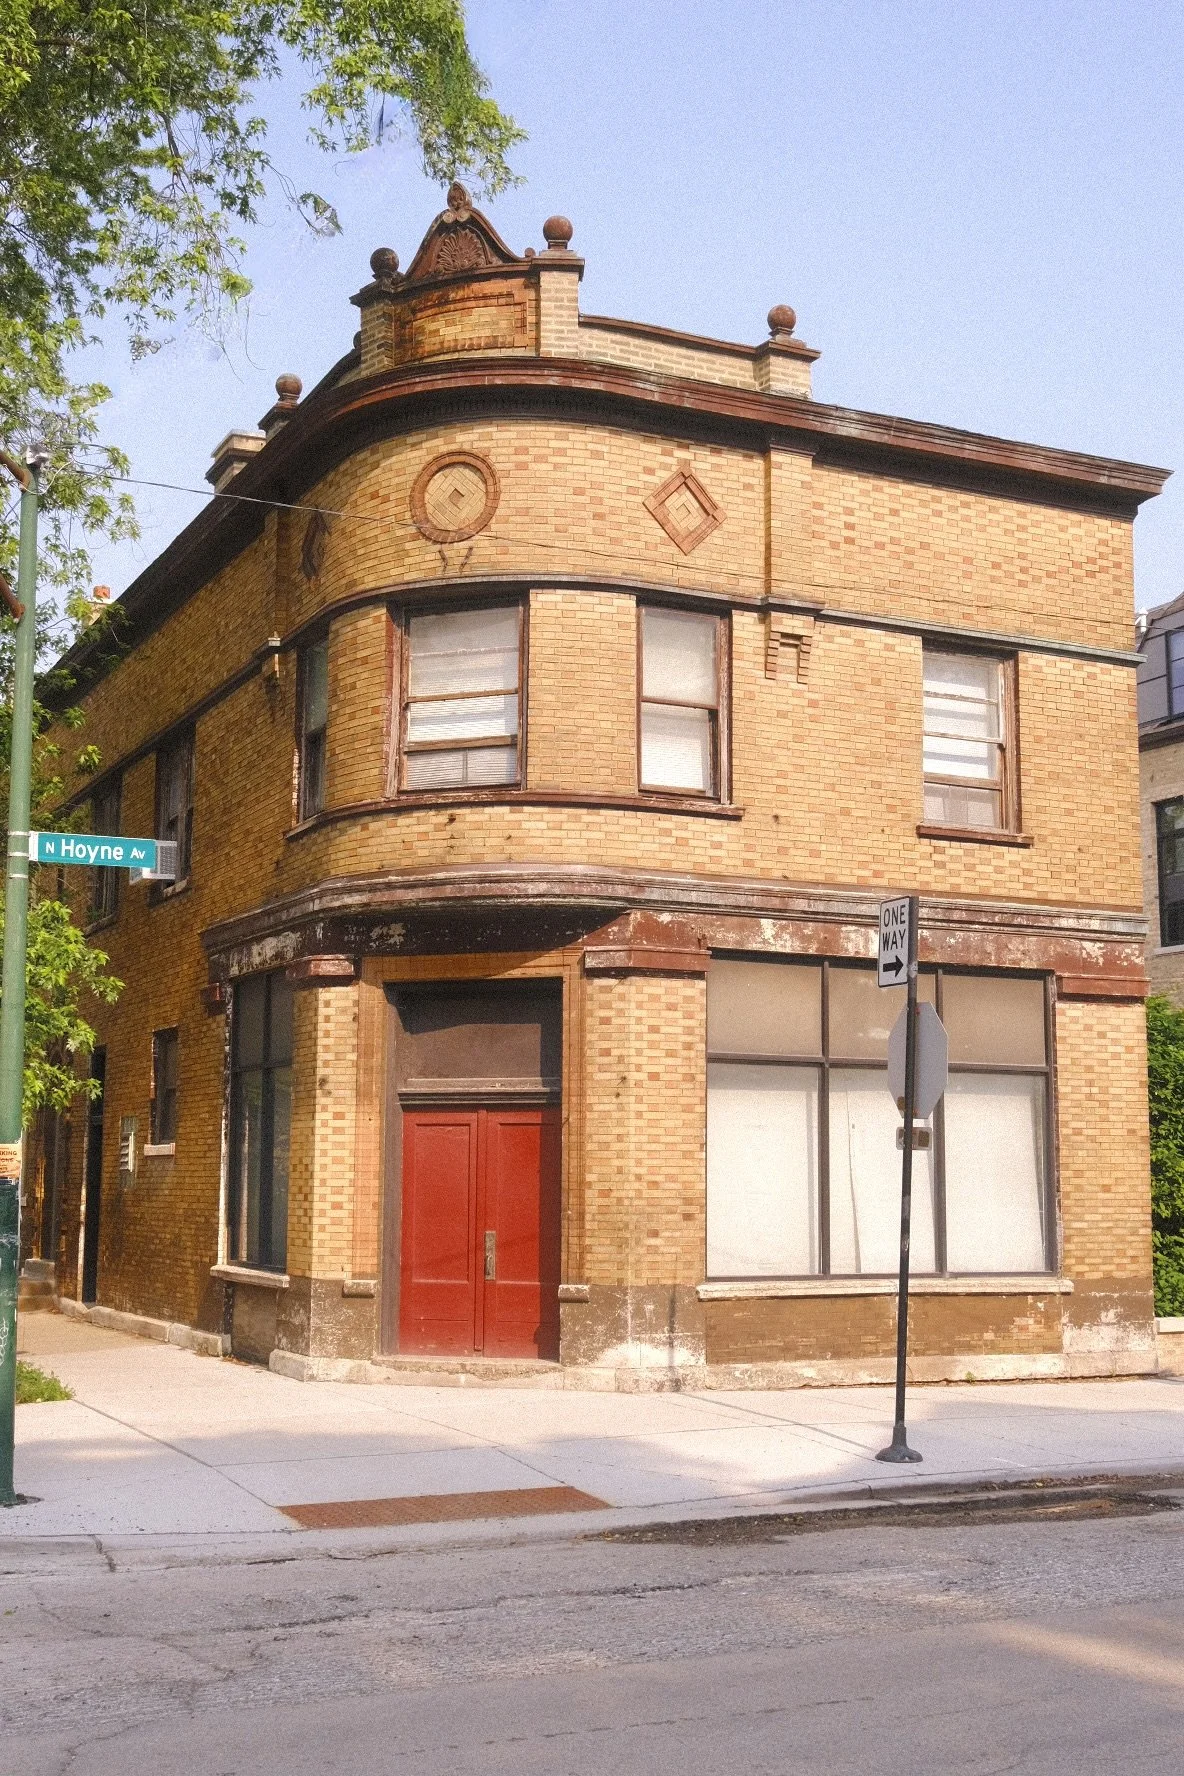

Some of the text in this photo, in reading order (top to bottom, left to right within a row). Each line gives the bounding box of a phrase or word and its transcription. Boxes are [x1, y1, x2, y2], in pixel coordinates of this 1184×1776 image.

[46, 839, 145, 863] N Hoyne Av
[883, 904, 906, 928] ONE
[882, 928, 906, 952] WAY
